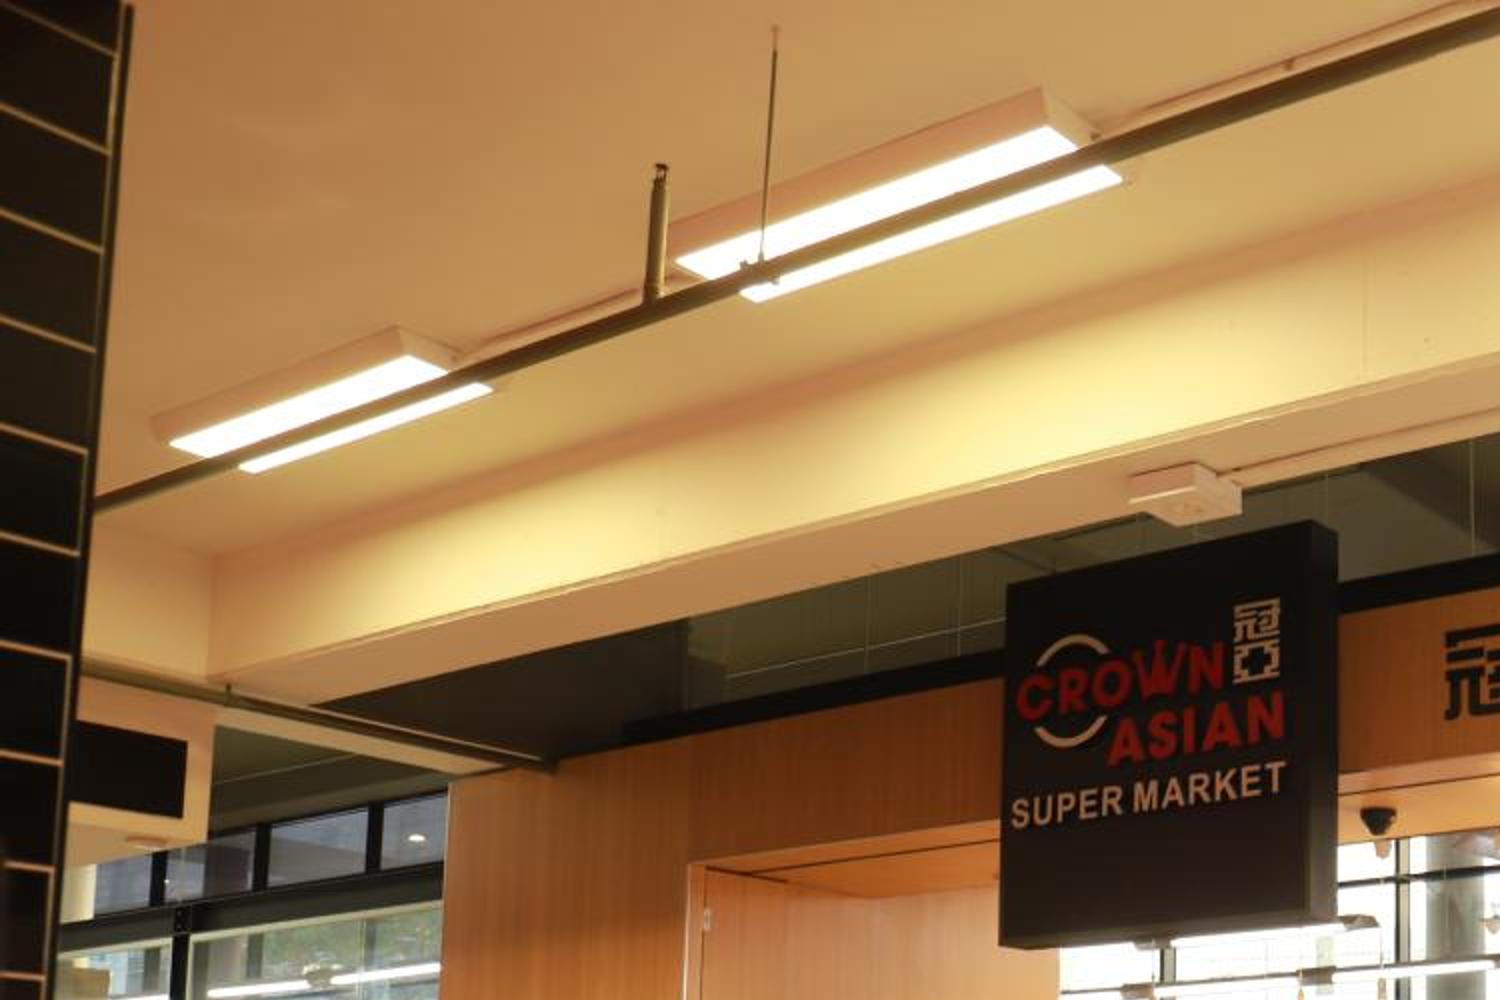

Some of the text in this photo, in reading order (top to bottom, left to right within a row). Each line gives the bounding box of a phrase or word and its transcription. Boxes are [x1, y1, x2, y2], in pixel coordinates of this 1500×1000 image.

[1016, 639, 1227, 720] CROWN
[1232, 597, 1281, 685] 冠亞
[1107, 690, 1286, 766] ASIAN
[1011, 760, 1287, 830] SUPER MARKET
